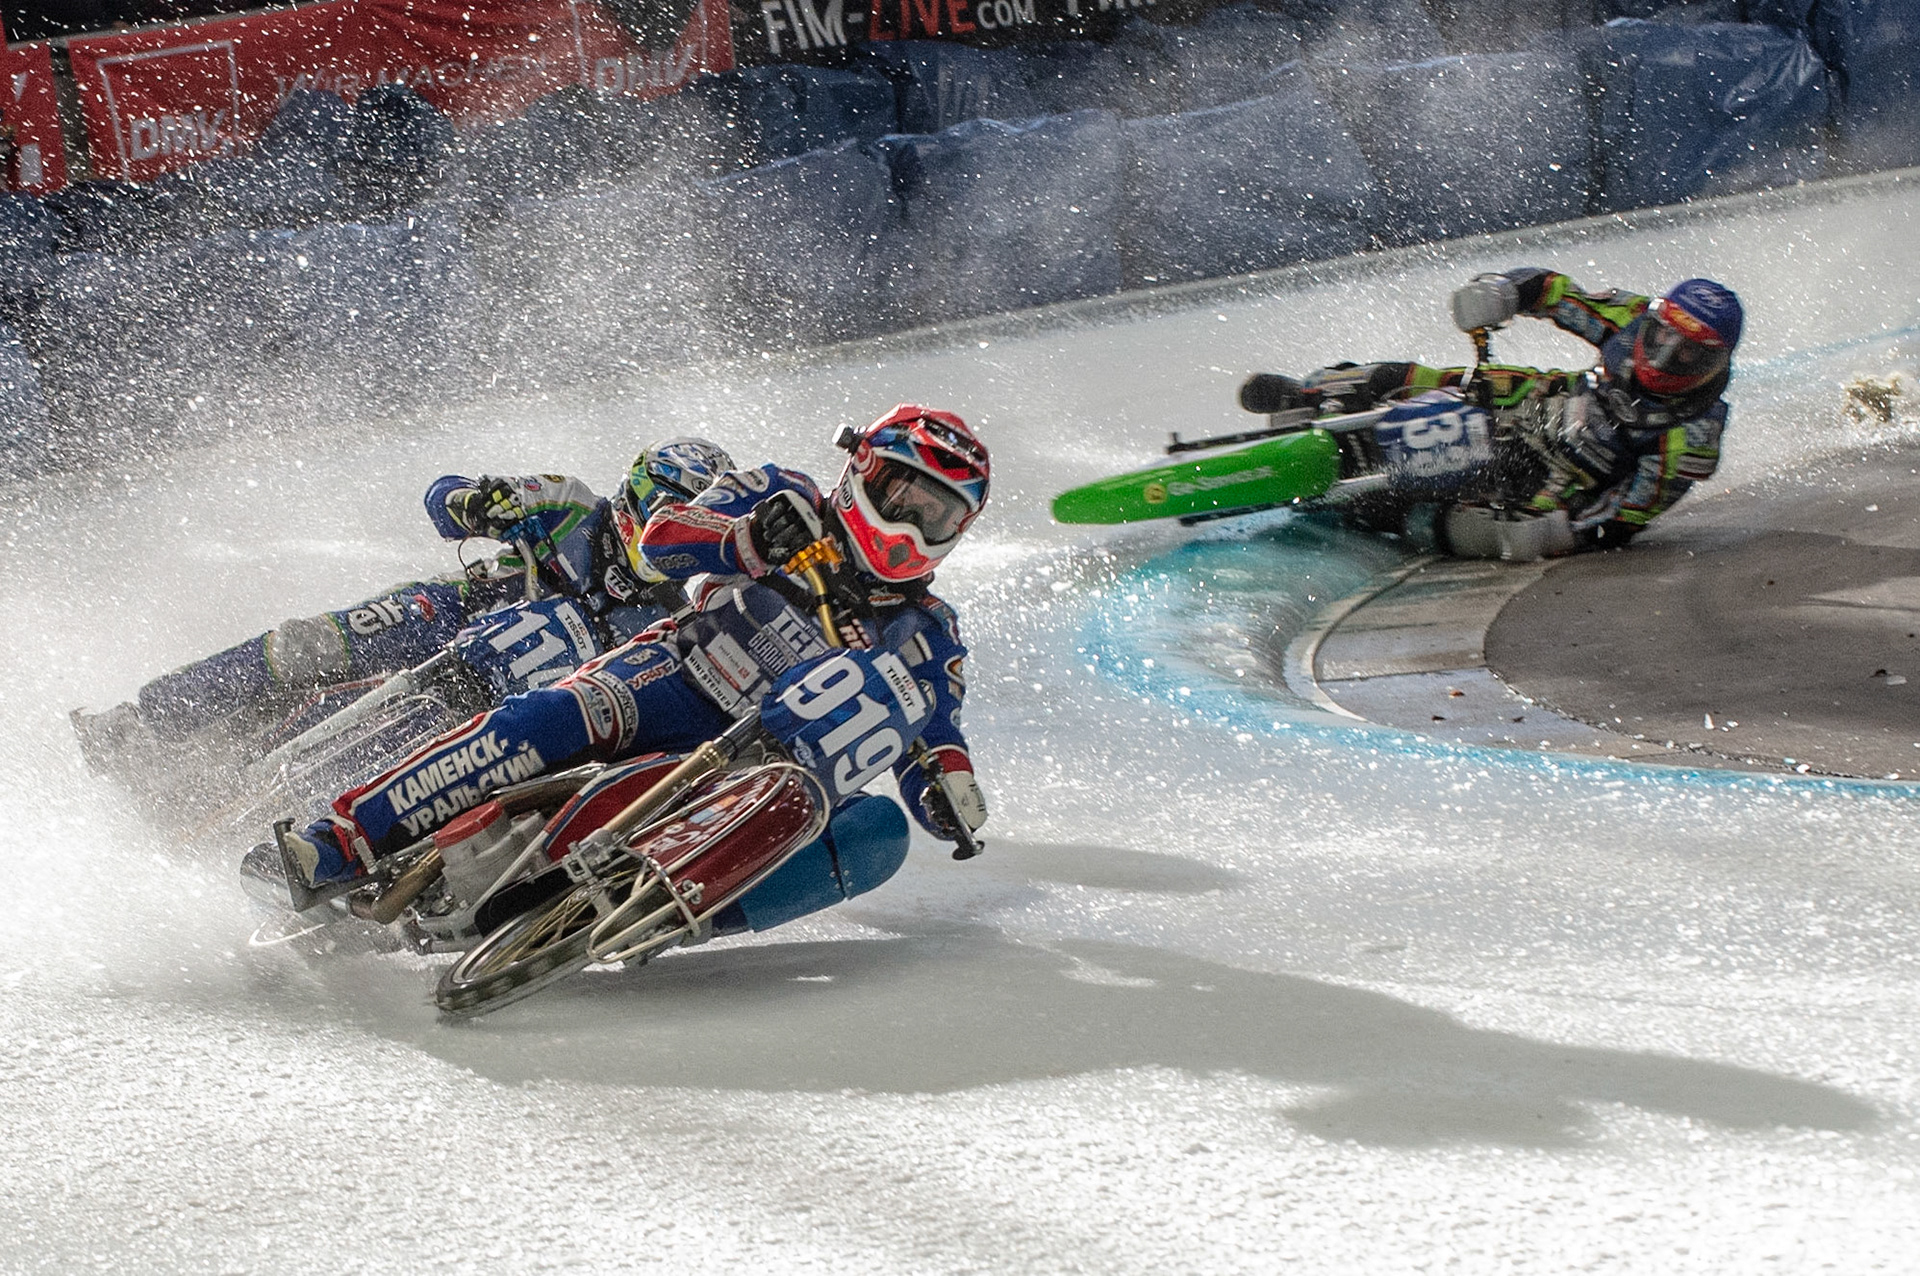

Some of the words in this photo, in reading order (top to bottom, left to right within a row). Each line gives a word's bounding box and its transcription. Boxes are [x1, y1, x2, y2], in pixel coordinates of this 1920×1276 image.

[348, 599, 405, 636] elf
[564, 613, 588, 651] TISSOT
[688, 655, 731, 709] HINTSTEINER
[886, 665, 915, 708] TISSOT
[782, 655, 904, 796] 919
[386, 730, 510, 816] КАМЕНСК-
[400, 740, 546, 838] УРАЛЬСКИЙ
